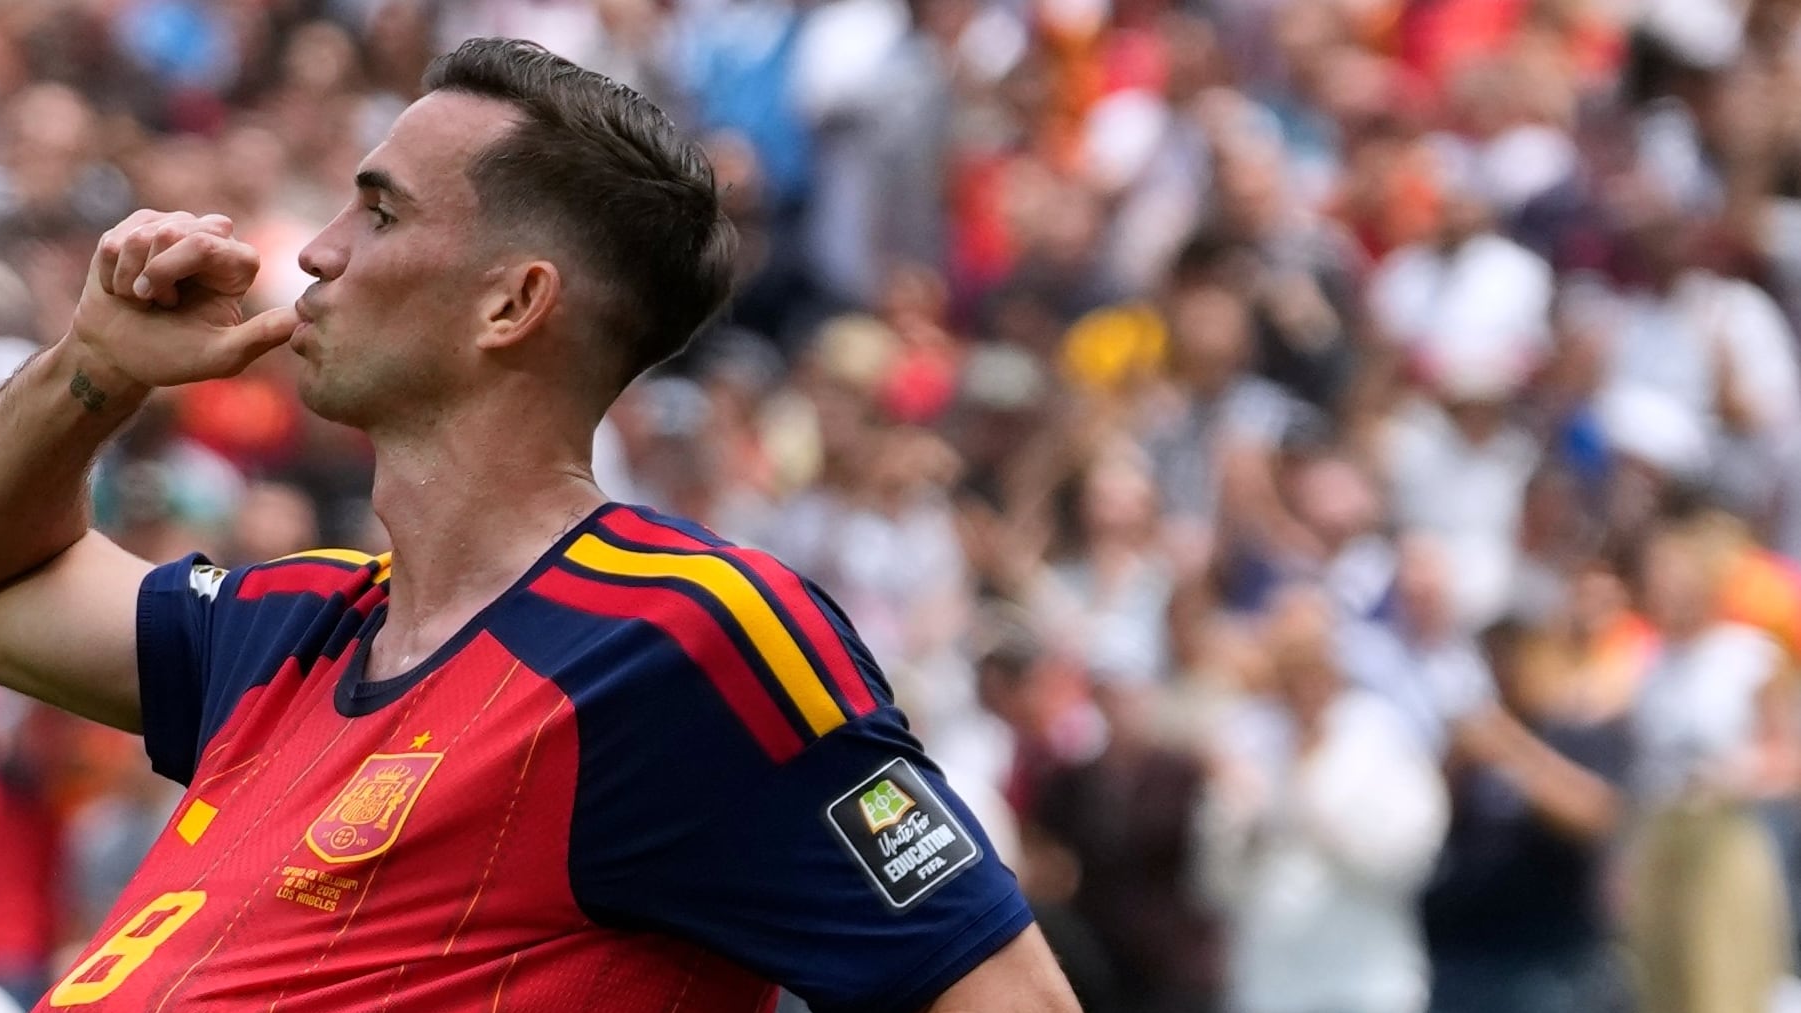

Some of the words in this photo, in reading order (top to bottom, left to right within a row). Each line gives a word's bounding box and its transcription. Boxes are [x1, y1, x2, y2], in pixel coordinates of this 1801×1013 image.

[879, 823, 914, 857] Unite
[908, 811, 930, 835] For
[884, 824, 956, 883] EDUCATION
[917, 856, 947, 880] FIFA
[276, 886, 295, 900] LOS
[296, 892, 337, 912] ANGELES
[316, 884, 341, 900] 2026
[50, 890, 207, 1008] 8
